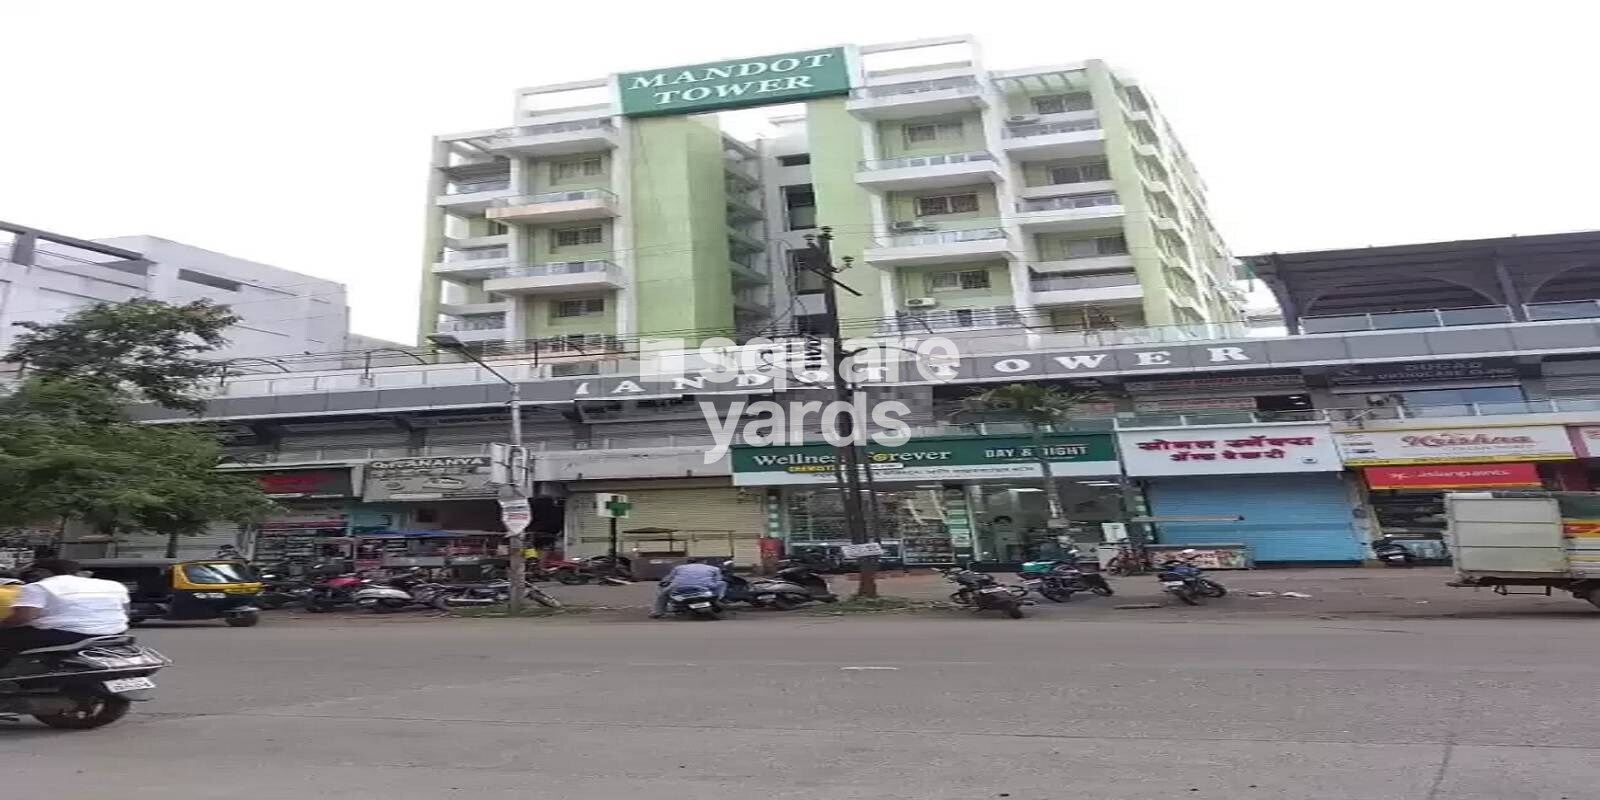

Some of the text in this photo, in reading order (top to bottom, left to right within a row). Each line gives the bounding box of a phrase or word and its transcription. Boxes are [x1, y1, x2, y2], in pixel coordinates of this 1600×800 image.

[628, 53, 832, 90] MANDOT
[653, 75, 814, 105] TOWER
[929, 347, 1249, 377] TOWER
[984, 448, 1014, 458] DAY
[1021, 448, 1032, 457] &
